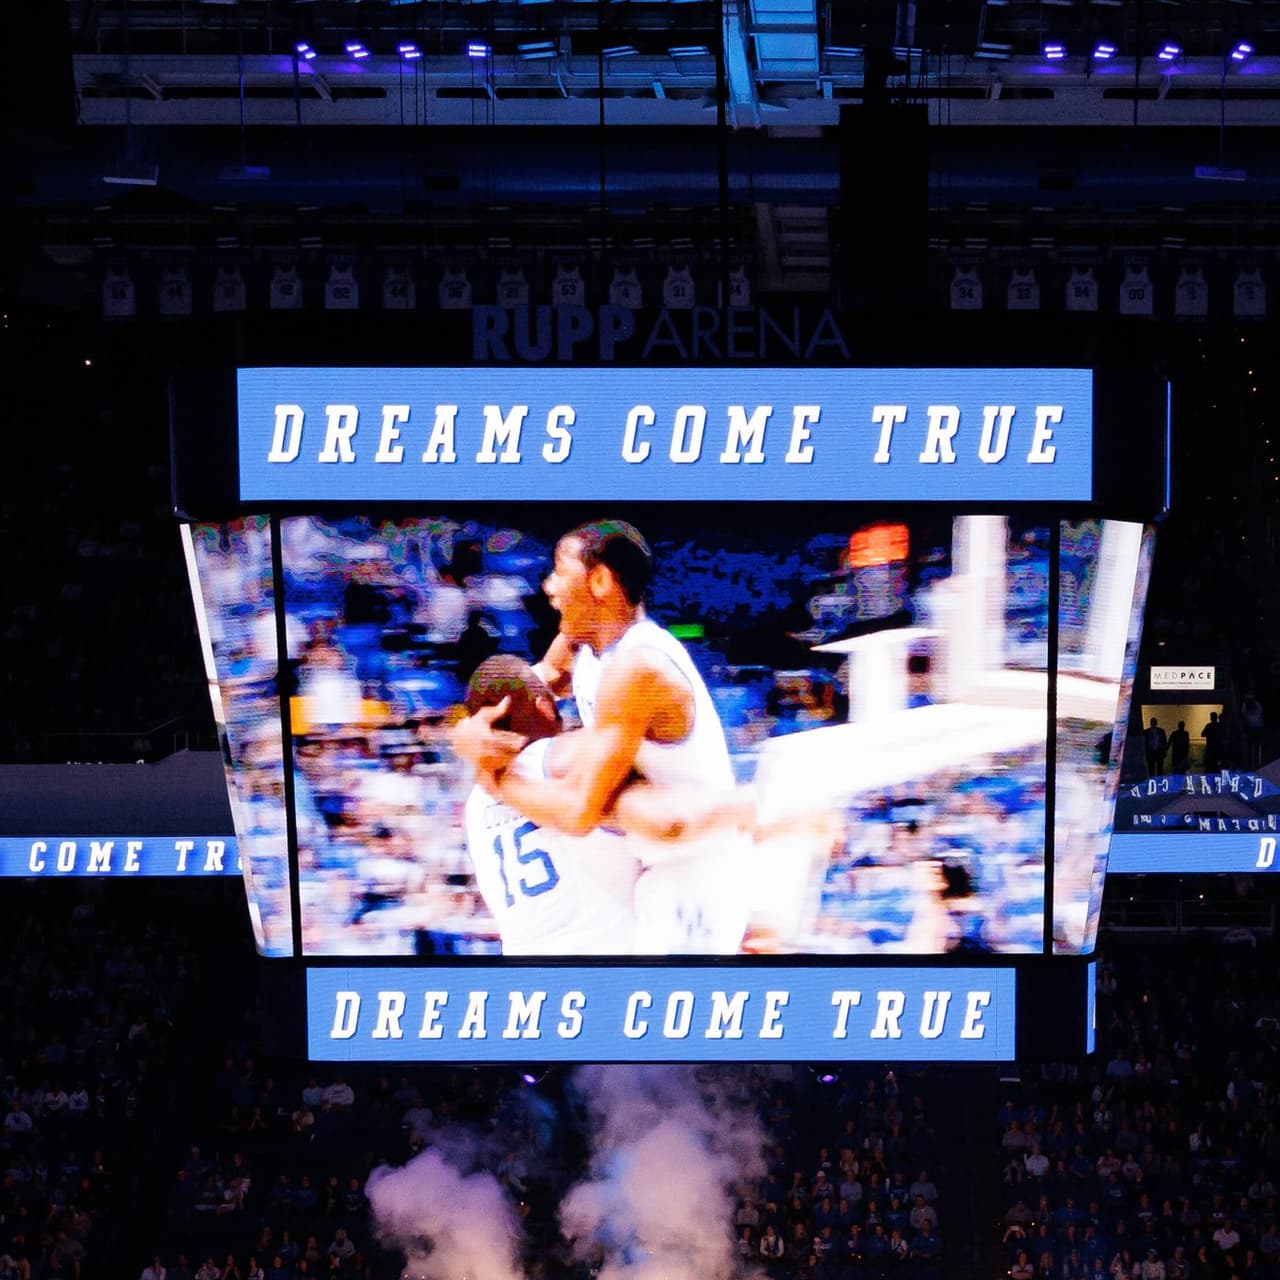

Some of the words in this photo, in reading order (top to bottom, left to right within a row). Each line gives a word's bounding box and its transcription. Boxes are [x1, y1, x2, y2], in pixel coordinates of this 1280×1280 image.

[470, 302, 638, 362] RUPP
[641, 302, 852, 361] ARENA
[267, 404, 577, 464] DREAMS
[621, 404, 821, 464] COME
[871, 405, 1064, 465] TRUE
[28, 840, 144, 872] COME
[174, 840, 244, 872] TR
[494, 821, 561, 907] 15
[330, 990, 587, 1039] DREAMS
[623, 989, 789, 1039] COME
[831, 989, 992, 1039] TRUE
